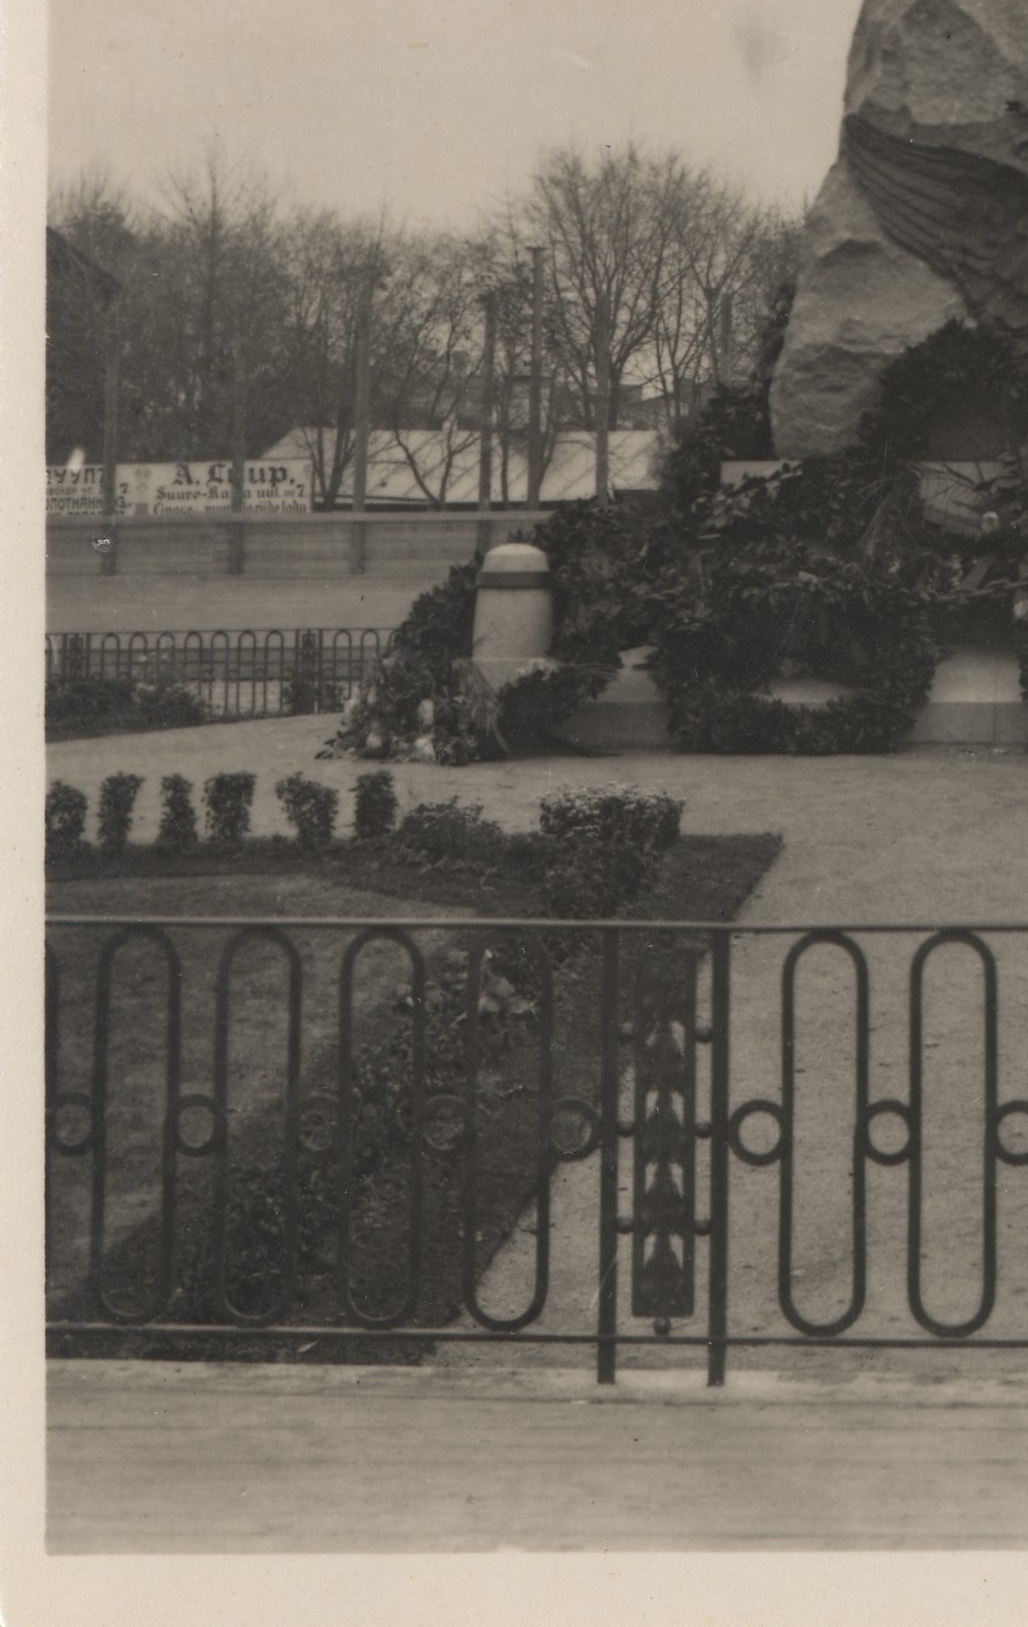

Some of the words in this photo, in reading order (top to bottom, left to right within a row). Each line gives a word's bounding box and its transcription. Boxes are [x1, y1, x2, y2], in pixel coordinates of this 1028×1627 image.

[171, 462, 200, 485] A.
[119, 482, 129, 494] 7
[296, 484, 306, 498] 7
